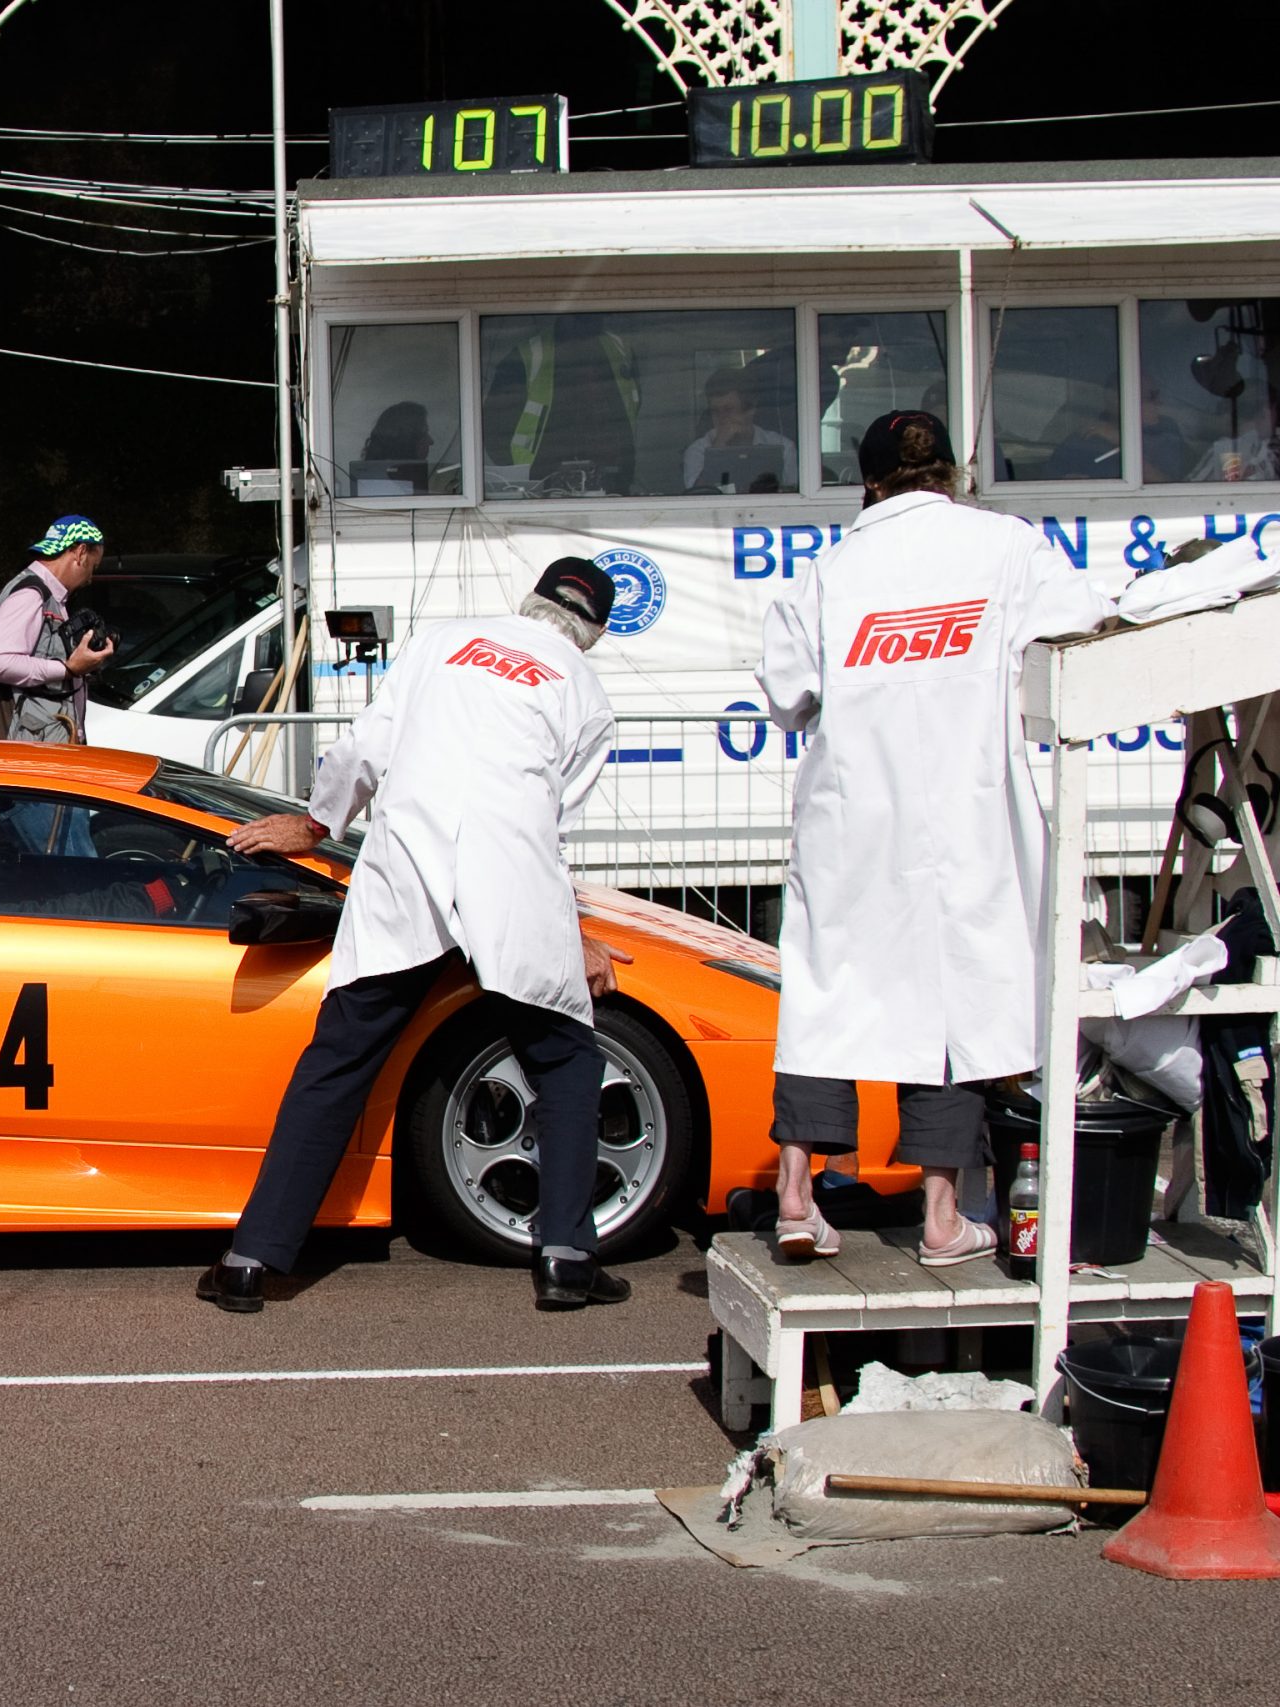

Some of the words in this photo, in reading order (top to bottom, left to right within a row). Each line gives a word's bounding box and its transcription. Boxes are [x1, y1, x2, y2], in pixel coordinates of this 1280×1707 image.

[422, 105, 547, 171] 107
[730, 83, 904, 157] 10.00
[614, 553, 644, 566] HOVE
[645, 565, 662, 602] MOTOR
[637, 605, 659, 627] CLUB
